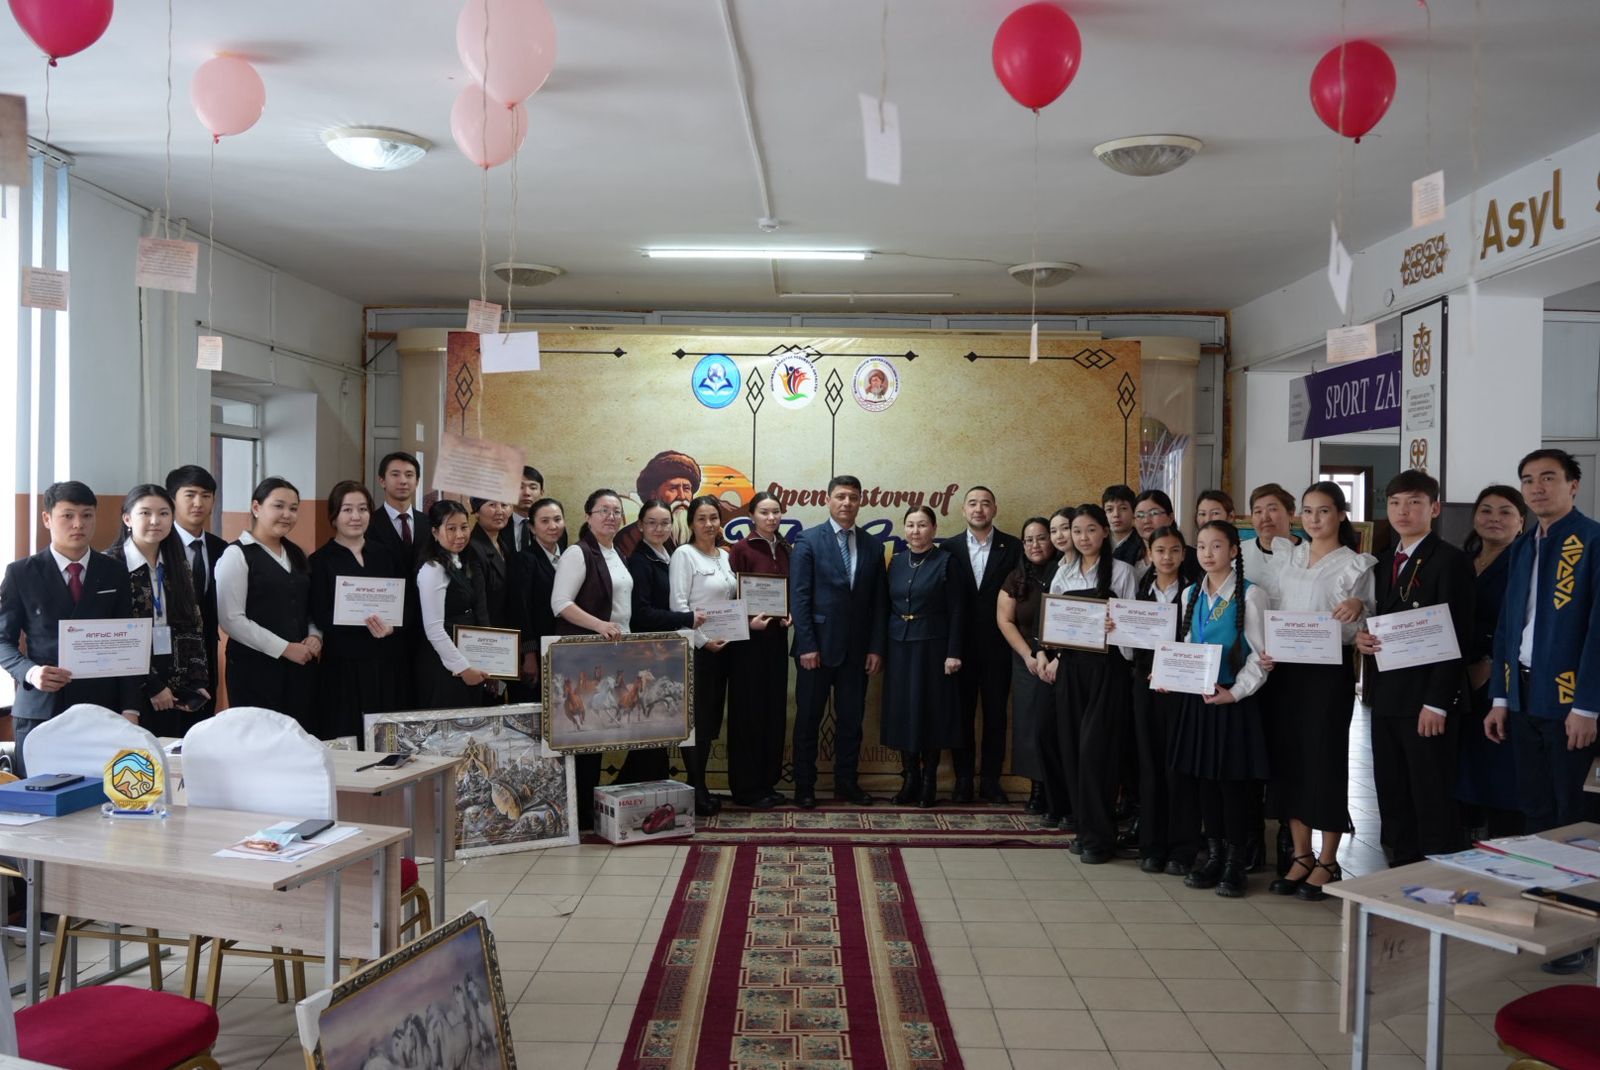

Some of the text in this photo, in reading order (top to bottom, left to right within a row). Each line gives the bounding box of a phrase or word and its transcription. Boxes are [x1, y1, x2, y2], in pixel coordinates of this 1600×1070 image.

[1480, 168, 1566, 260] Asyl
[1325, 377, 1370, 420] SPORT
[929, 483, 960, 517] of
